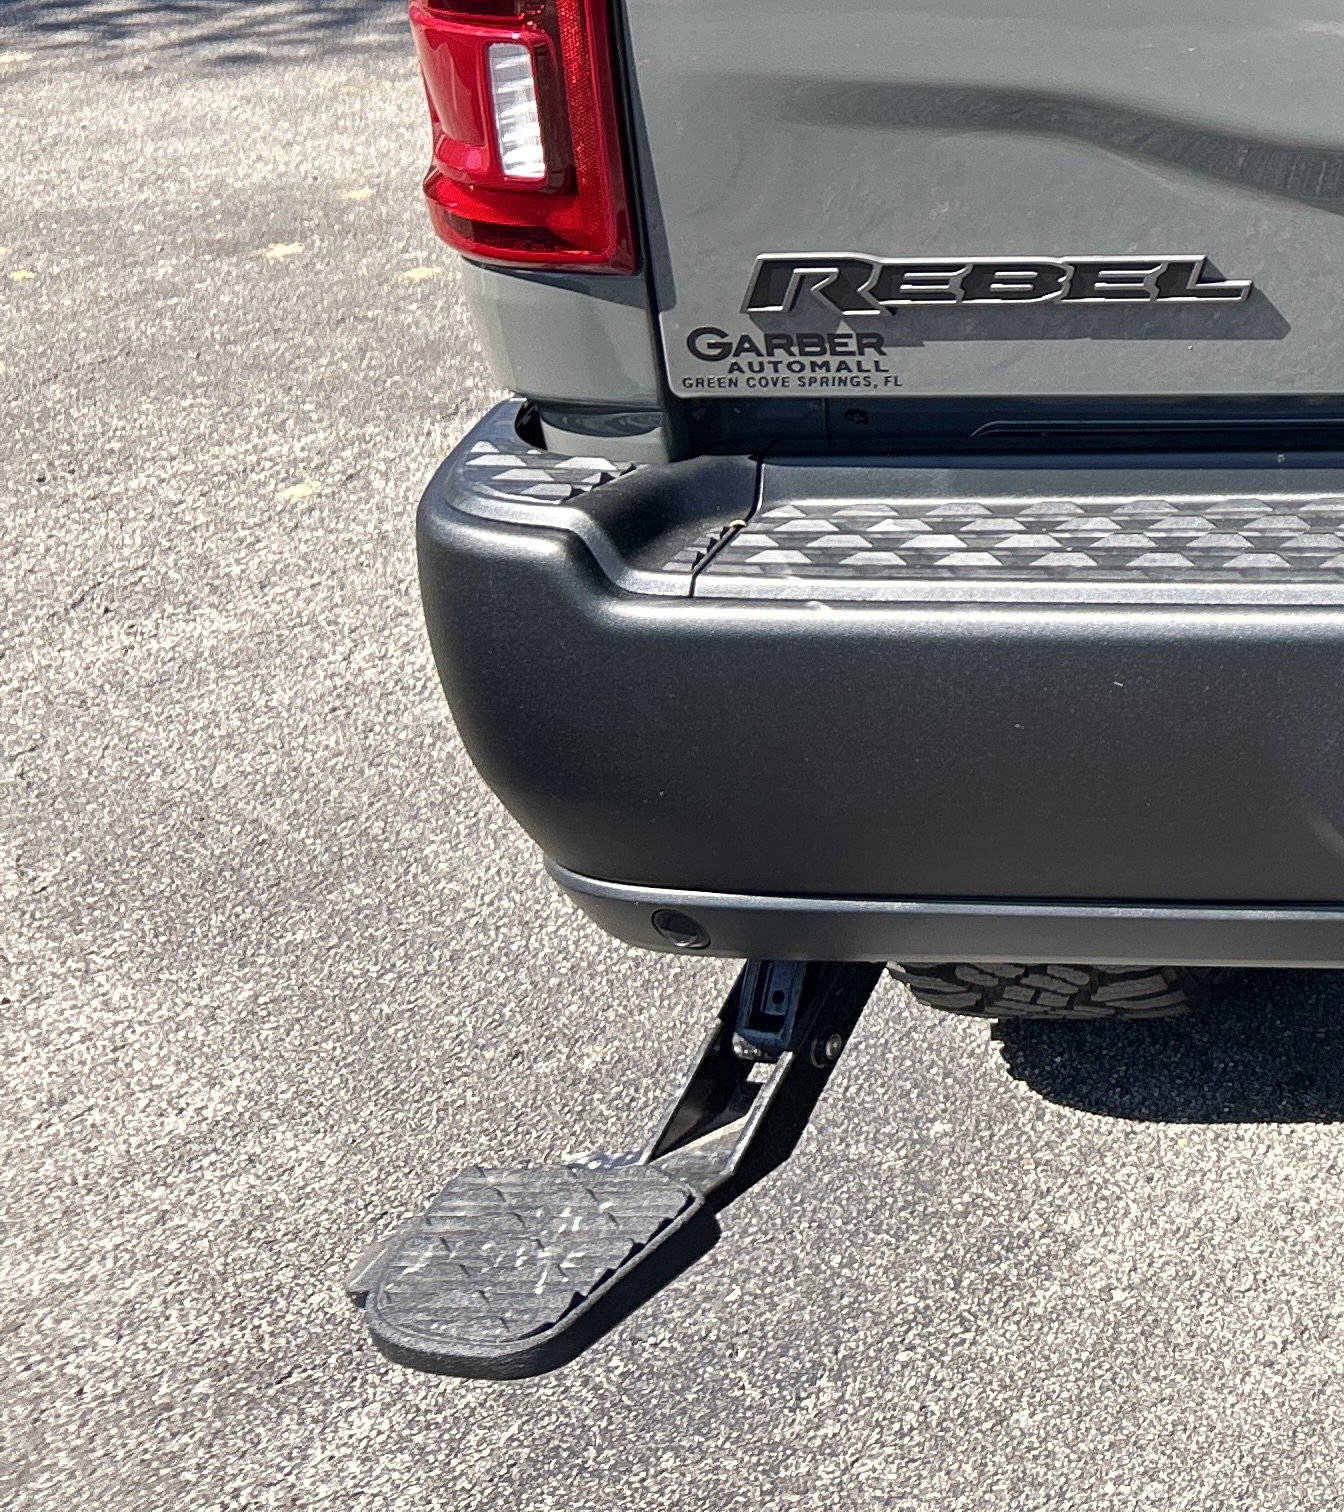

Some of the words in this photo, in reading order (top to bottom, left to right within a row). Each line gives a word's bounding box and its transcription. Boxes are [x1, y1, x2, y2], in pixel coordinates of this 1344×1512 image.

[740, 252, 1254, 316] REBEL
[686, 326, 887, 362] GARBER
[727, 360, 889, 374] AUTOMALL
[682, 377, 738, 388] GREEN
[746, 376, 790, 388] COVE
[797, 376, 877, 389] SPRINGS,
[883, 376, 903, 387] FL
